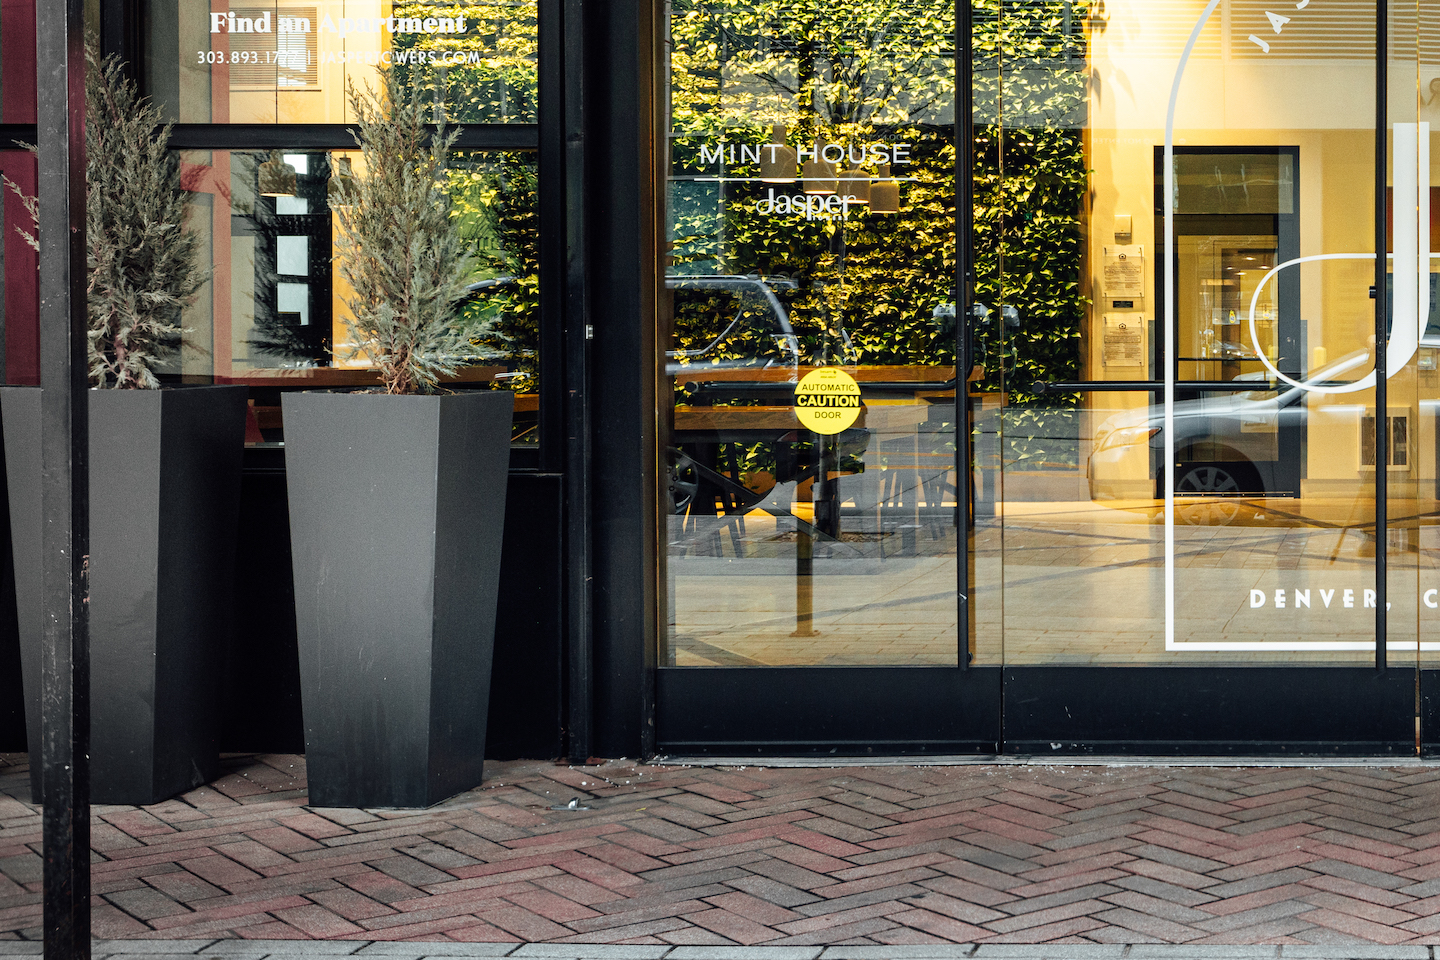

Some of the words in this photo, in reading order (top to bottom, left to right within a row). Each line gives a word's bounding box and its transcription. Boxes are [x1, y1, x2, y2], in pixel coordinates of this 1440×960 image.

[210, 11, 271, 33] Find
[278, 18, 311, 33] an
[318, 14, 467, 37] Apartment
[319, 50, 481, 64] JASPERTOWERSCOM
[700, 144, 783, 164] MINT
[796, 144, 911, 164] HOUSE
[756, 188, 856, 221] Jasper
[796, 395, 859, 407] CAUTION
[1249, 589, 1392, 611] DENVER,
